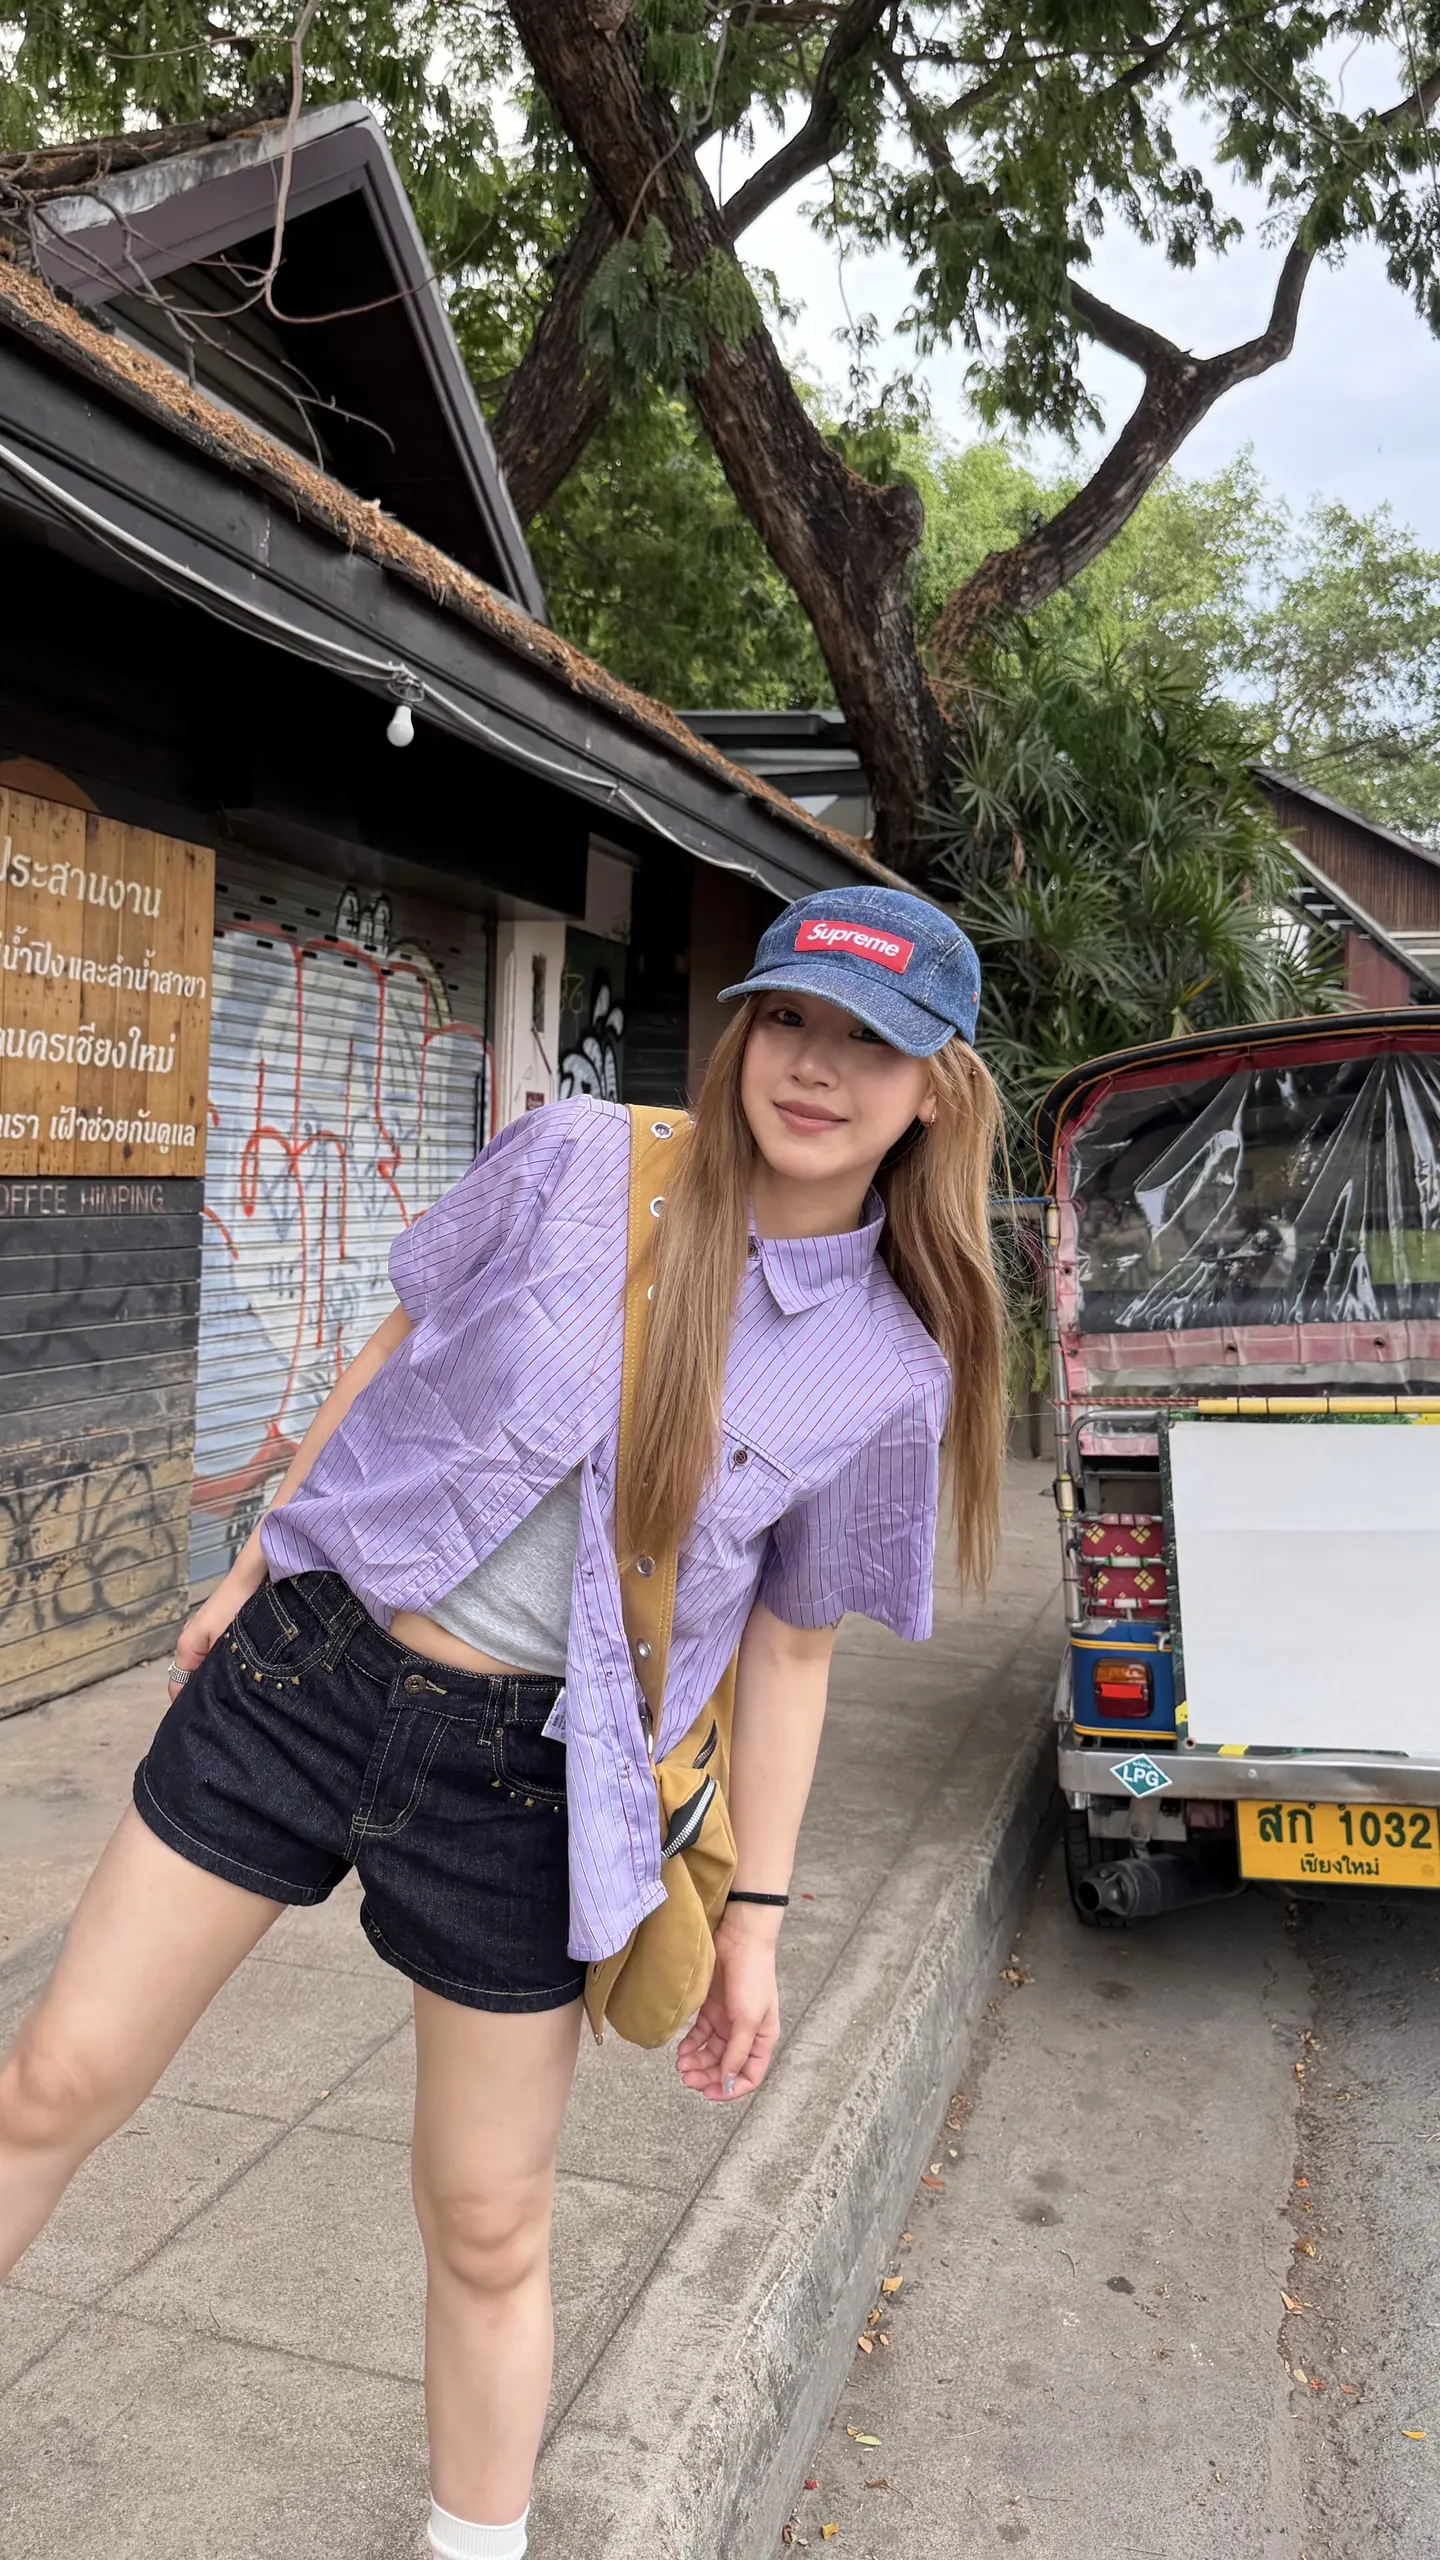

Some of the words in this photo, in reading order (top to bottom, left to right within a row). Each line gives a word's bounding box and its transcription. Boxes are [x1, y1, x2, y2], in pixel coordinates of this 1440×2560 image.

[807, 923, 900, 957] Supreme
[0, 1022, 177, 1073] นครเชียงใหม่
[0, 1113, 40, 1140] เรา
[1123, 1765, 1159, 1787] LPG
[1257, 1804, 1313, 1844] สก
[1339, 1810, 1432, 1849] 1032
[1300, 1853, 1380, 1876] เชียงใหม่
